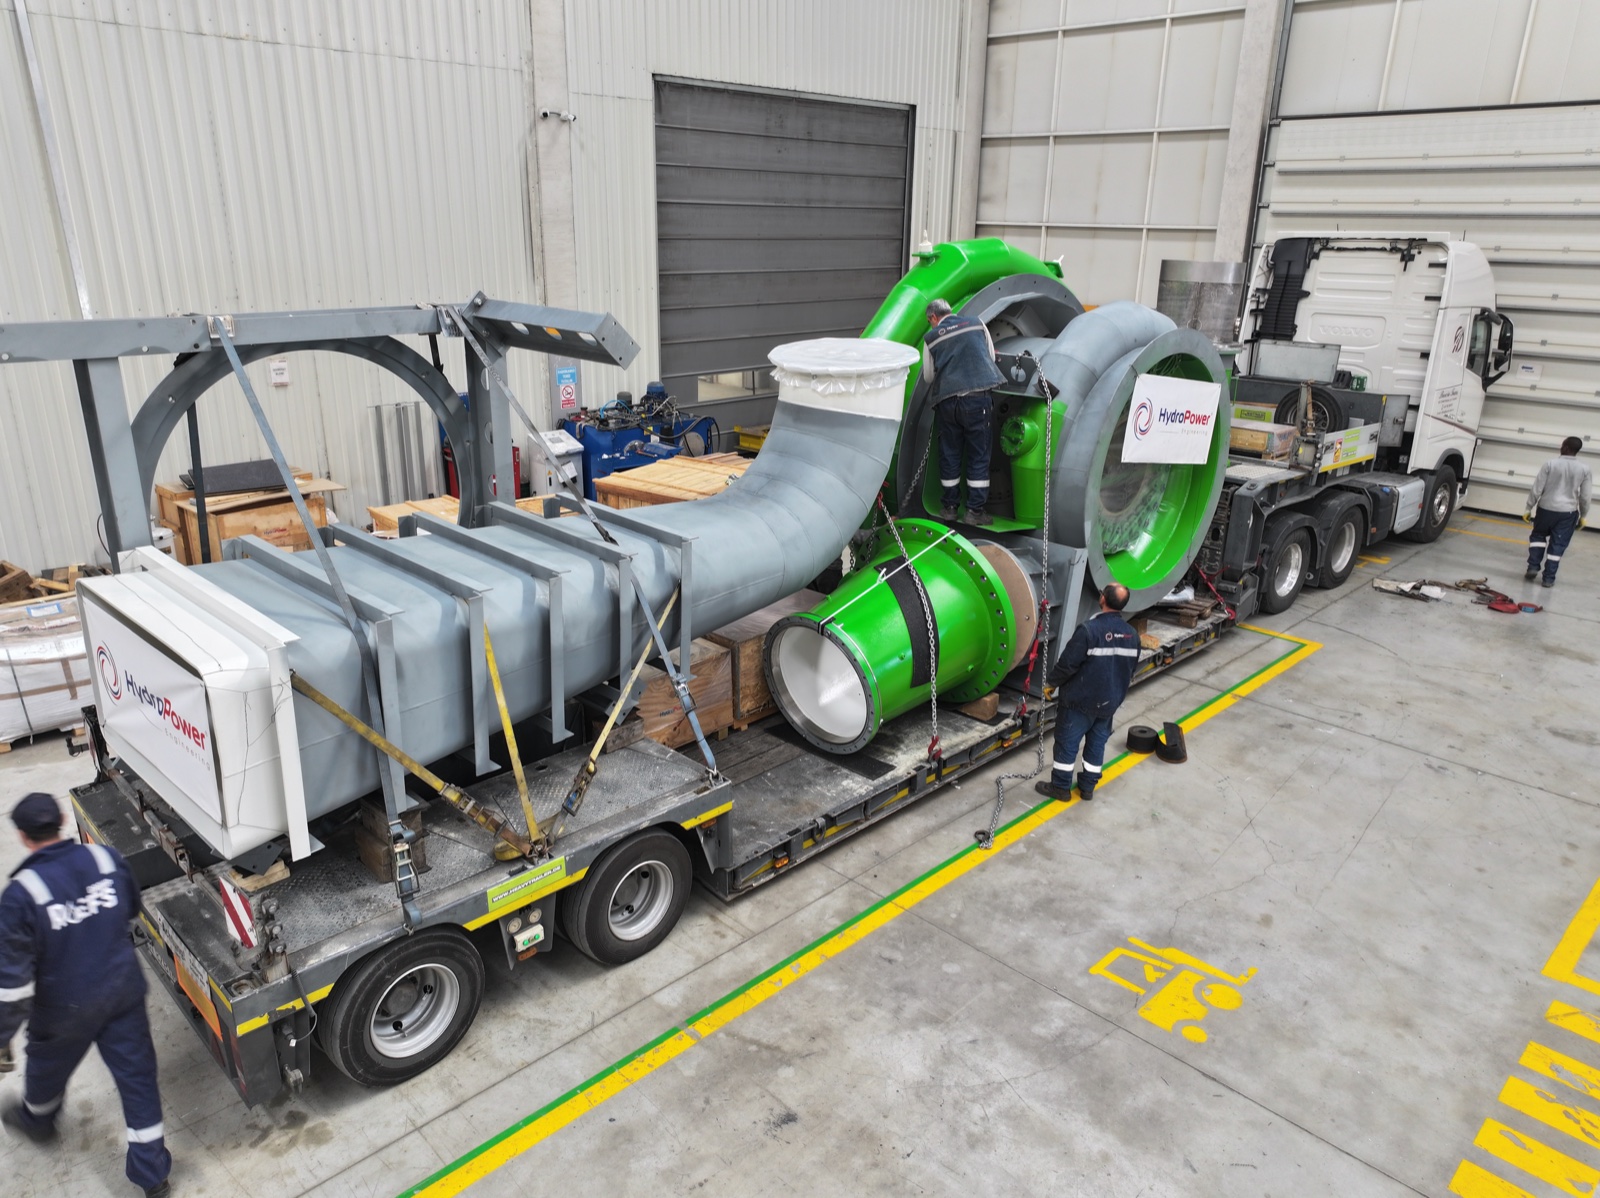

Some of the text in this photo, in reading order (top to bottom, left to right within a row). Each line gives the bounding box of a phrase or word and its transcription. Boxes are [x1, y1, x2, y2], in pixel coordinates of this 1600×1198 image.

[1320, 324, 1375, 338] VOLVO
[1158, 407, 1211, 426] HydroPower
[124, 669, 206, 751] HydroPower
[164, 726, 211, 772] Engineering
